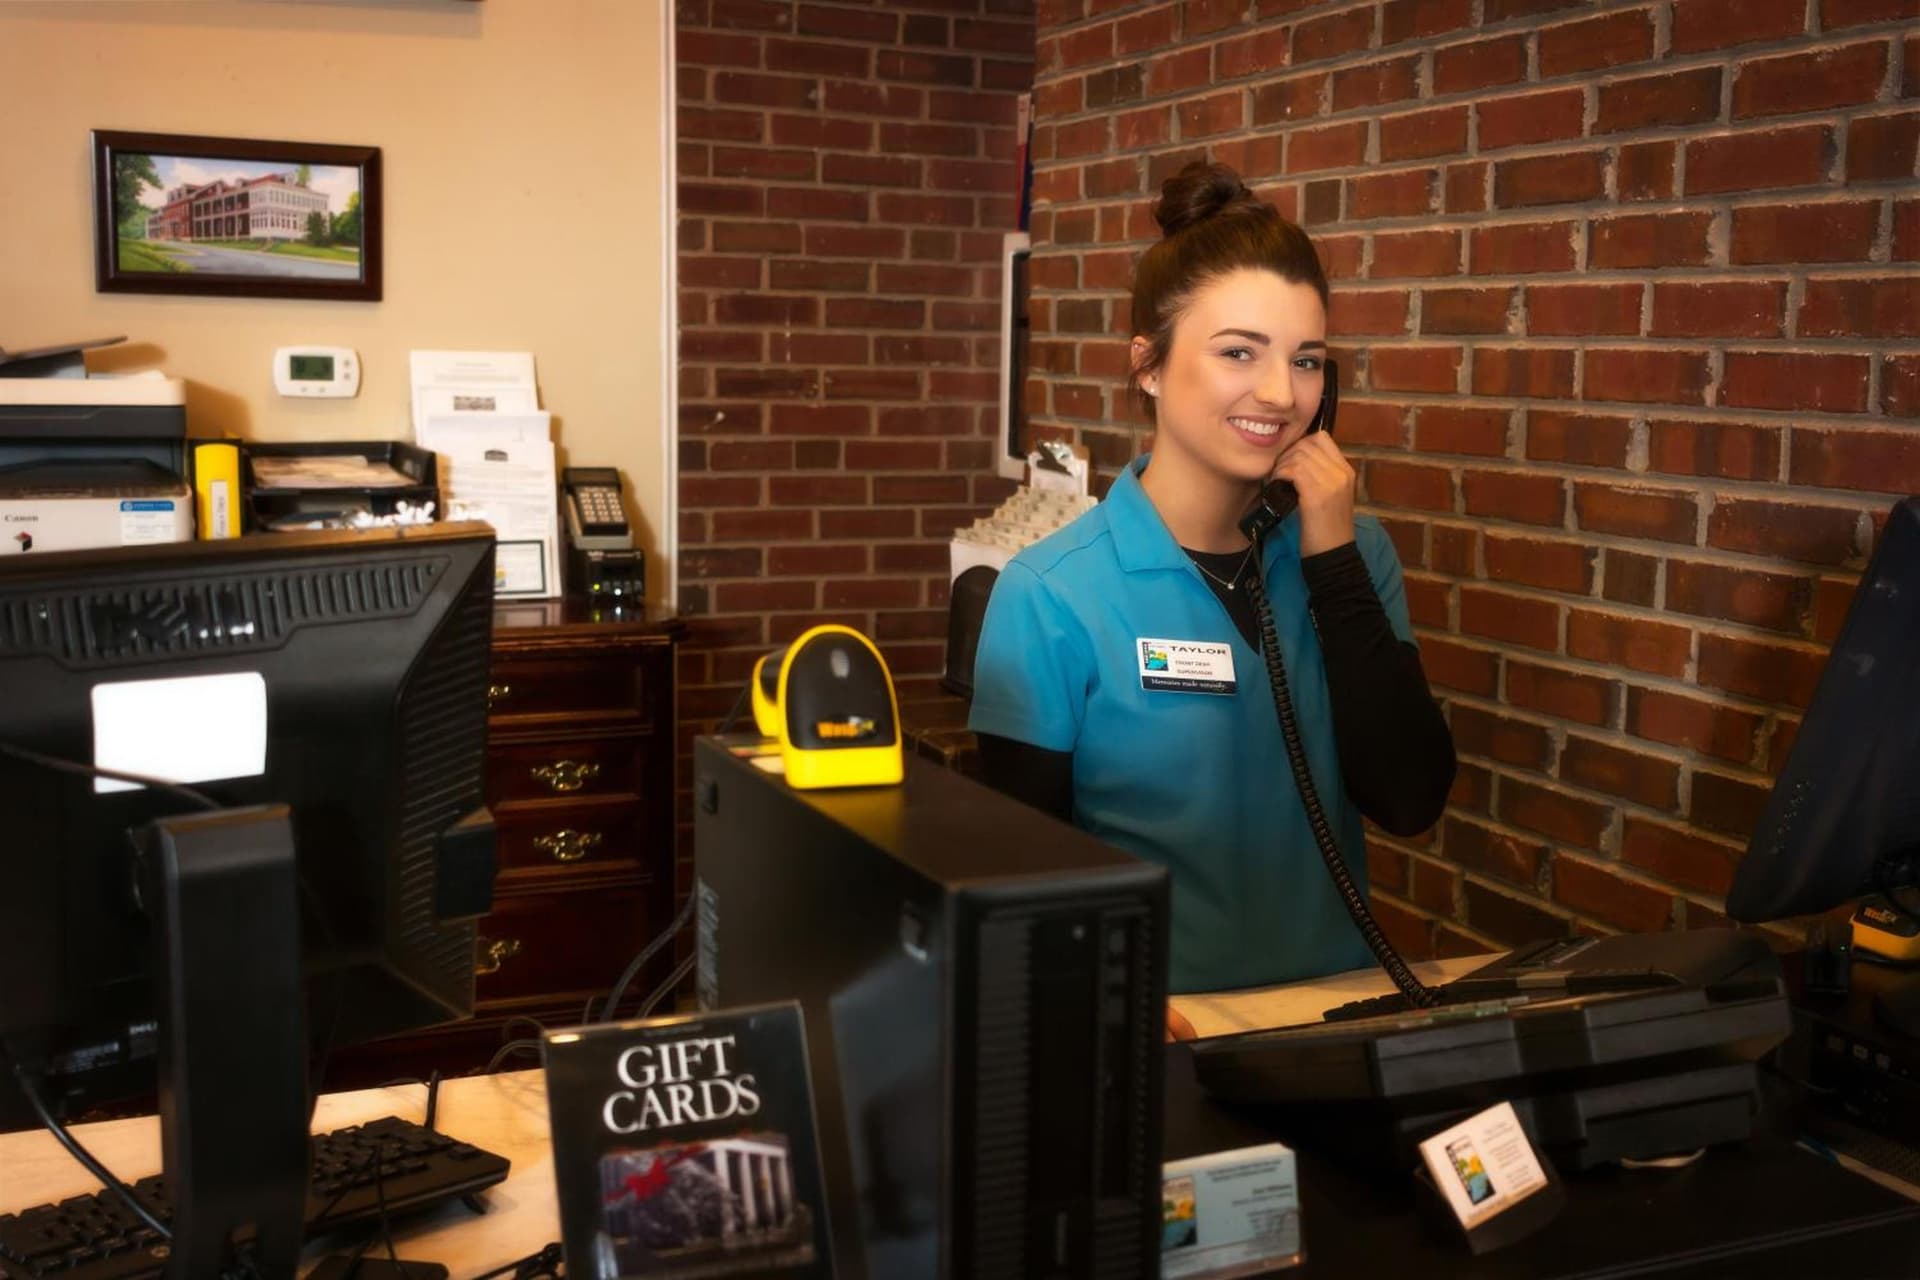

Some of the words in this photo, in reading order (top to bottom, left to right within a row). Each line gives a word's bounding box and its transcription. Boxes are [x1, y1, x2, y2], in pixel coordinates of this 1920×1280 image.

[4, 513, 39, 523] Canon
[1170, 646, 1226, 655] TAYLOR
[617, 1035, 736, 1089] GIFT
[603, 1073, 760, 1134] CARDS
